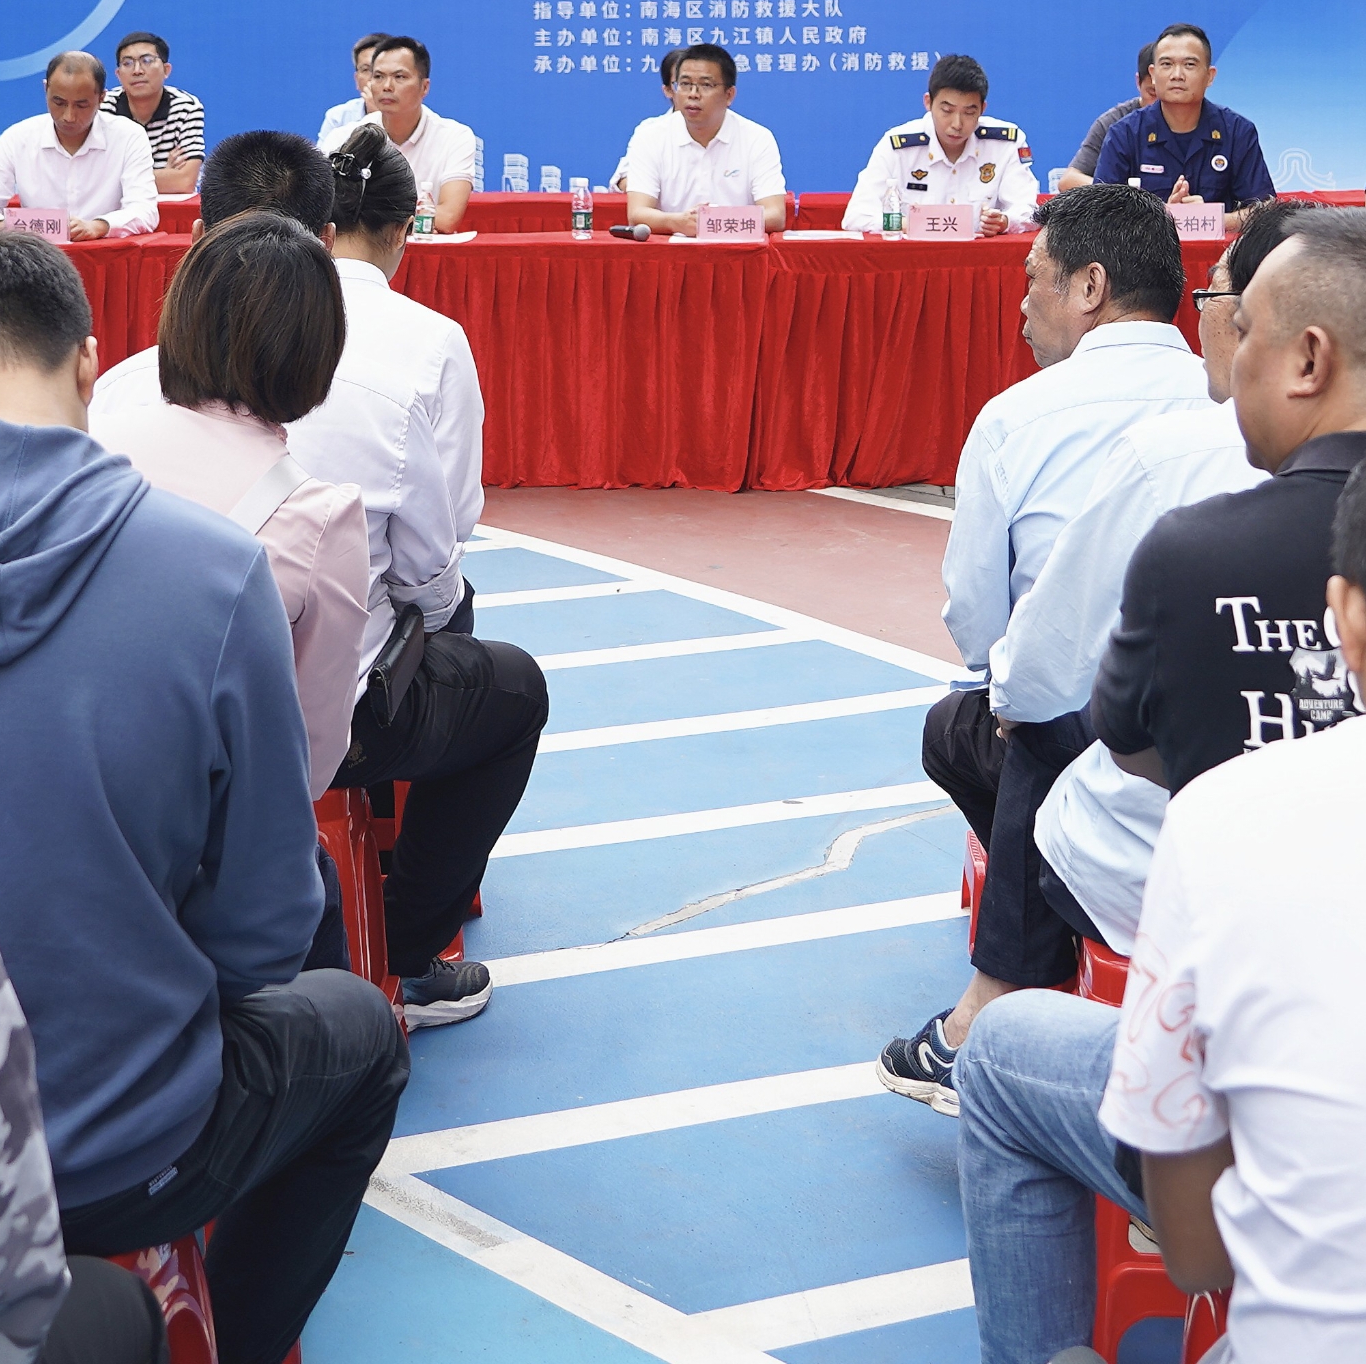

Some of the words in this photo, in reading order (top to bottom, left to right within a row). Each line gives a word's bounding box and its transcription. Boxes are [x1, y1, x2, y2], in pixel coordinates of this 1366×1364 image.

[534, 51, 942, 74] 承办单位：九急管理办（消防救援
[706, 218, 756, 234] 邹荣坤
[925, 216, 958, 232] 王兴
[1298, 698, 1345, 710] ADVENTURE
[1310, 709, 1334, 722] CAMP
